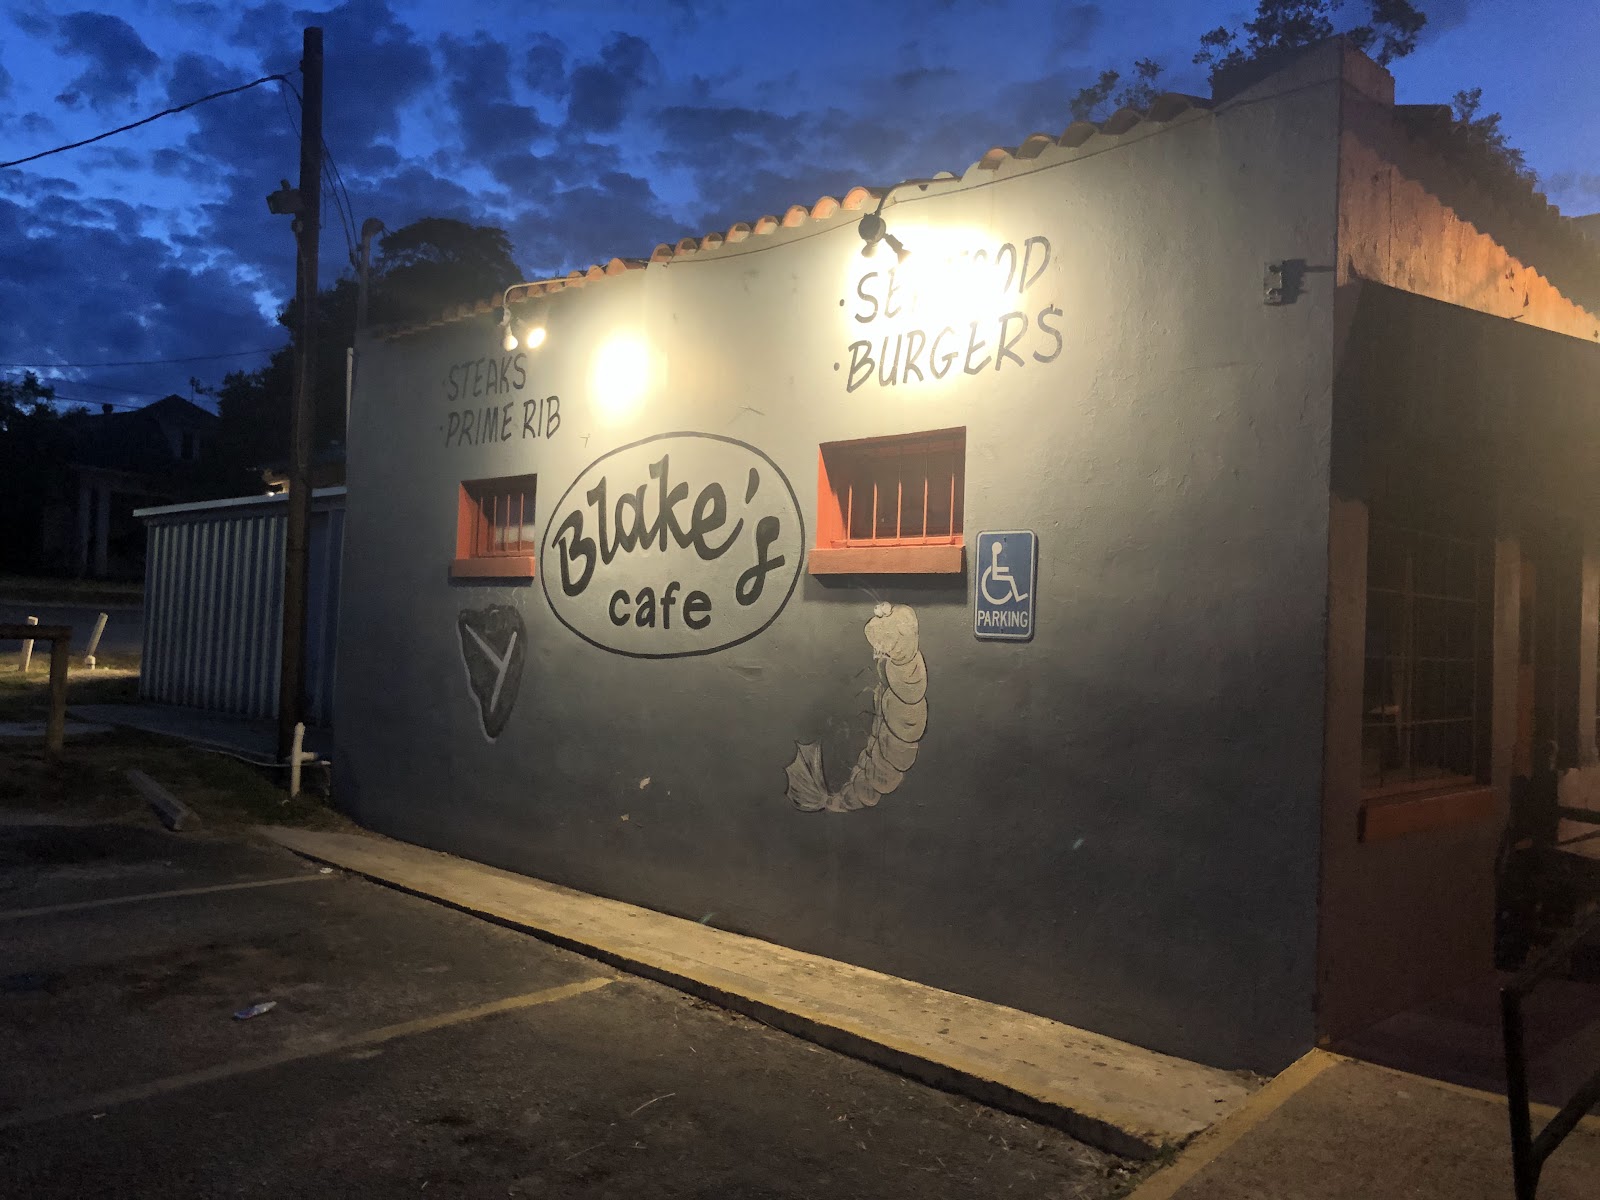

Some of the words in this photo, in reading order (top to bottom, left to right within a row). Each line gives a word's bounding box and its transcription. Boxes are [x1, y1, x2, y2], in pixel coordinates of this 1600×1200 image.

[855, 235, 1051, 323] SEOD
[846, 303, 1063, 393] BURGERS
[448, 353, 527, 401] STEAKS
[446, 401, 514, 448] PRIME
[522, 395, 561, 440] RIB
[551, 453, 785, 606] Blake's
[608, 581, 712, 630] cafe
[977, 610, 1029, 628] PARKING
